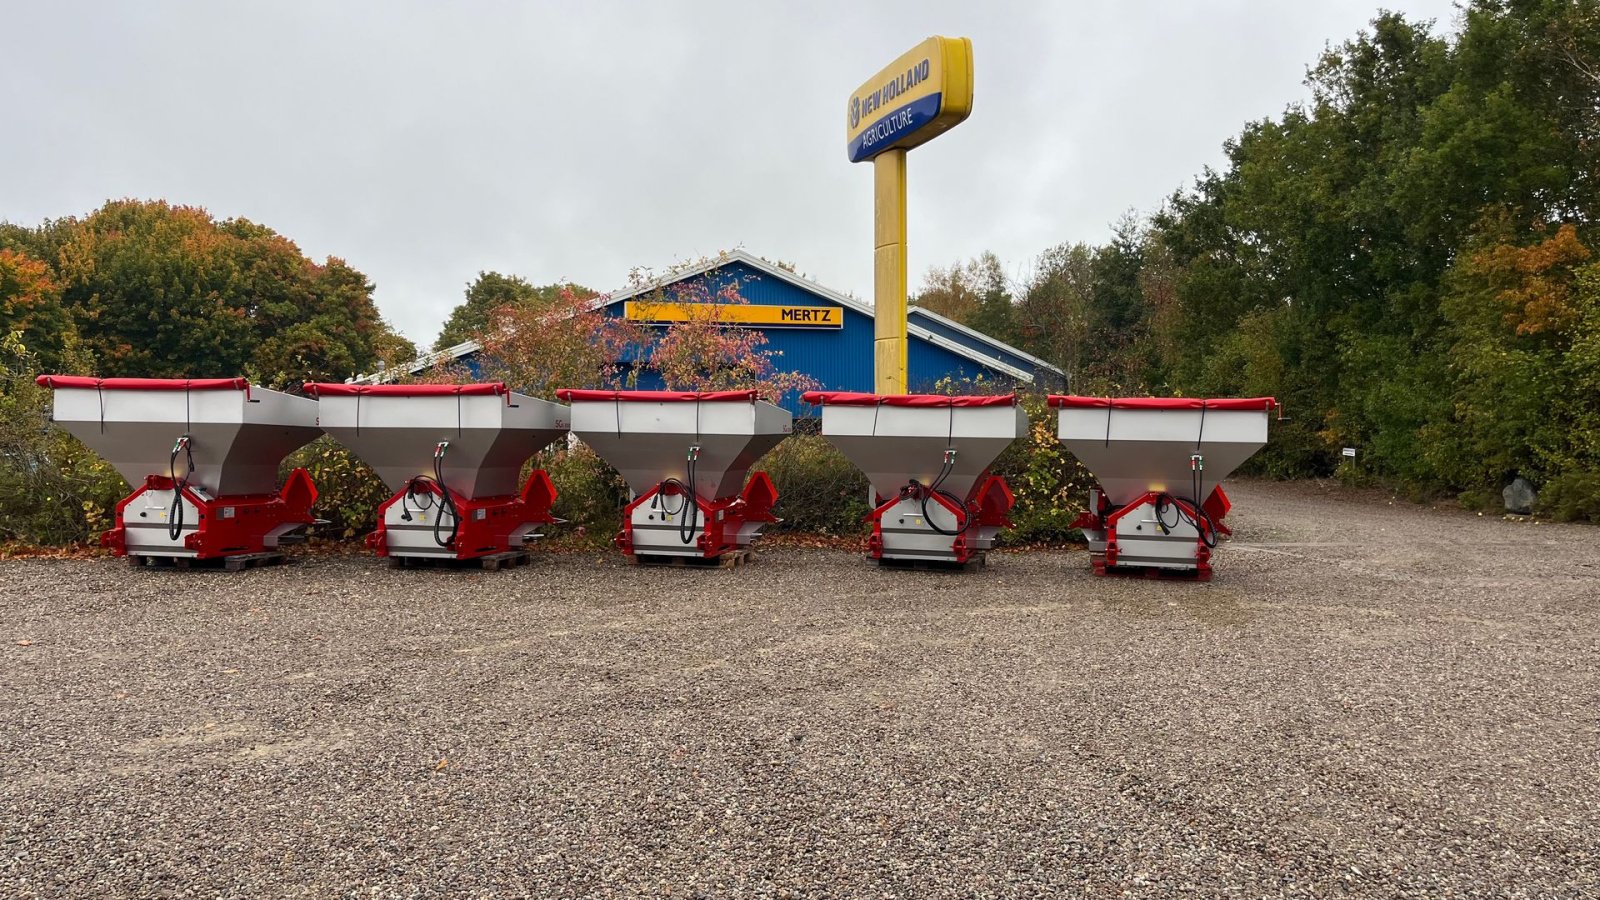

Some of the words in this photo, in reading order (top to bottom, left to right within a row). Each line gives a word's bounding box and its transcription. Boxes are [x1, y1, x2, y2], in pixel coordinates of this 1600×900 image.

[862, 89, 881, 118] NEW
[882, 59, 929, 105] HOLLAND
[863, 107, 913, 149] AGRICULTURE
[781, 309, 831, 321] MERTZ
